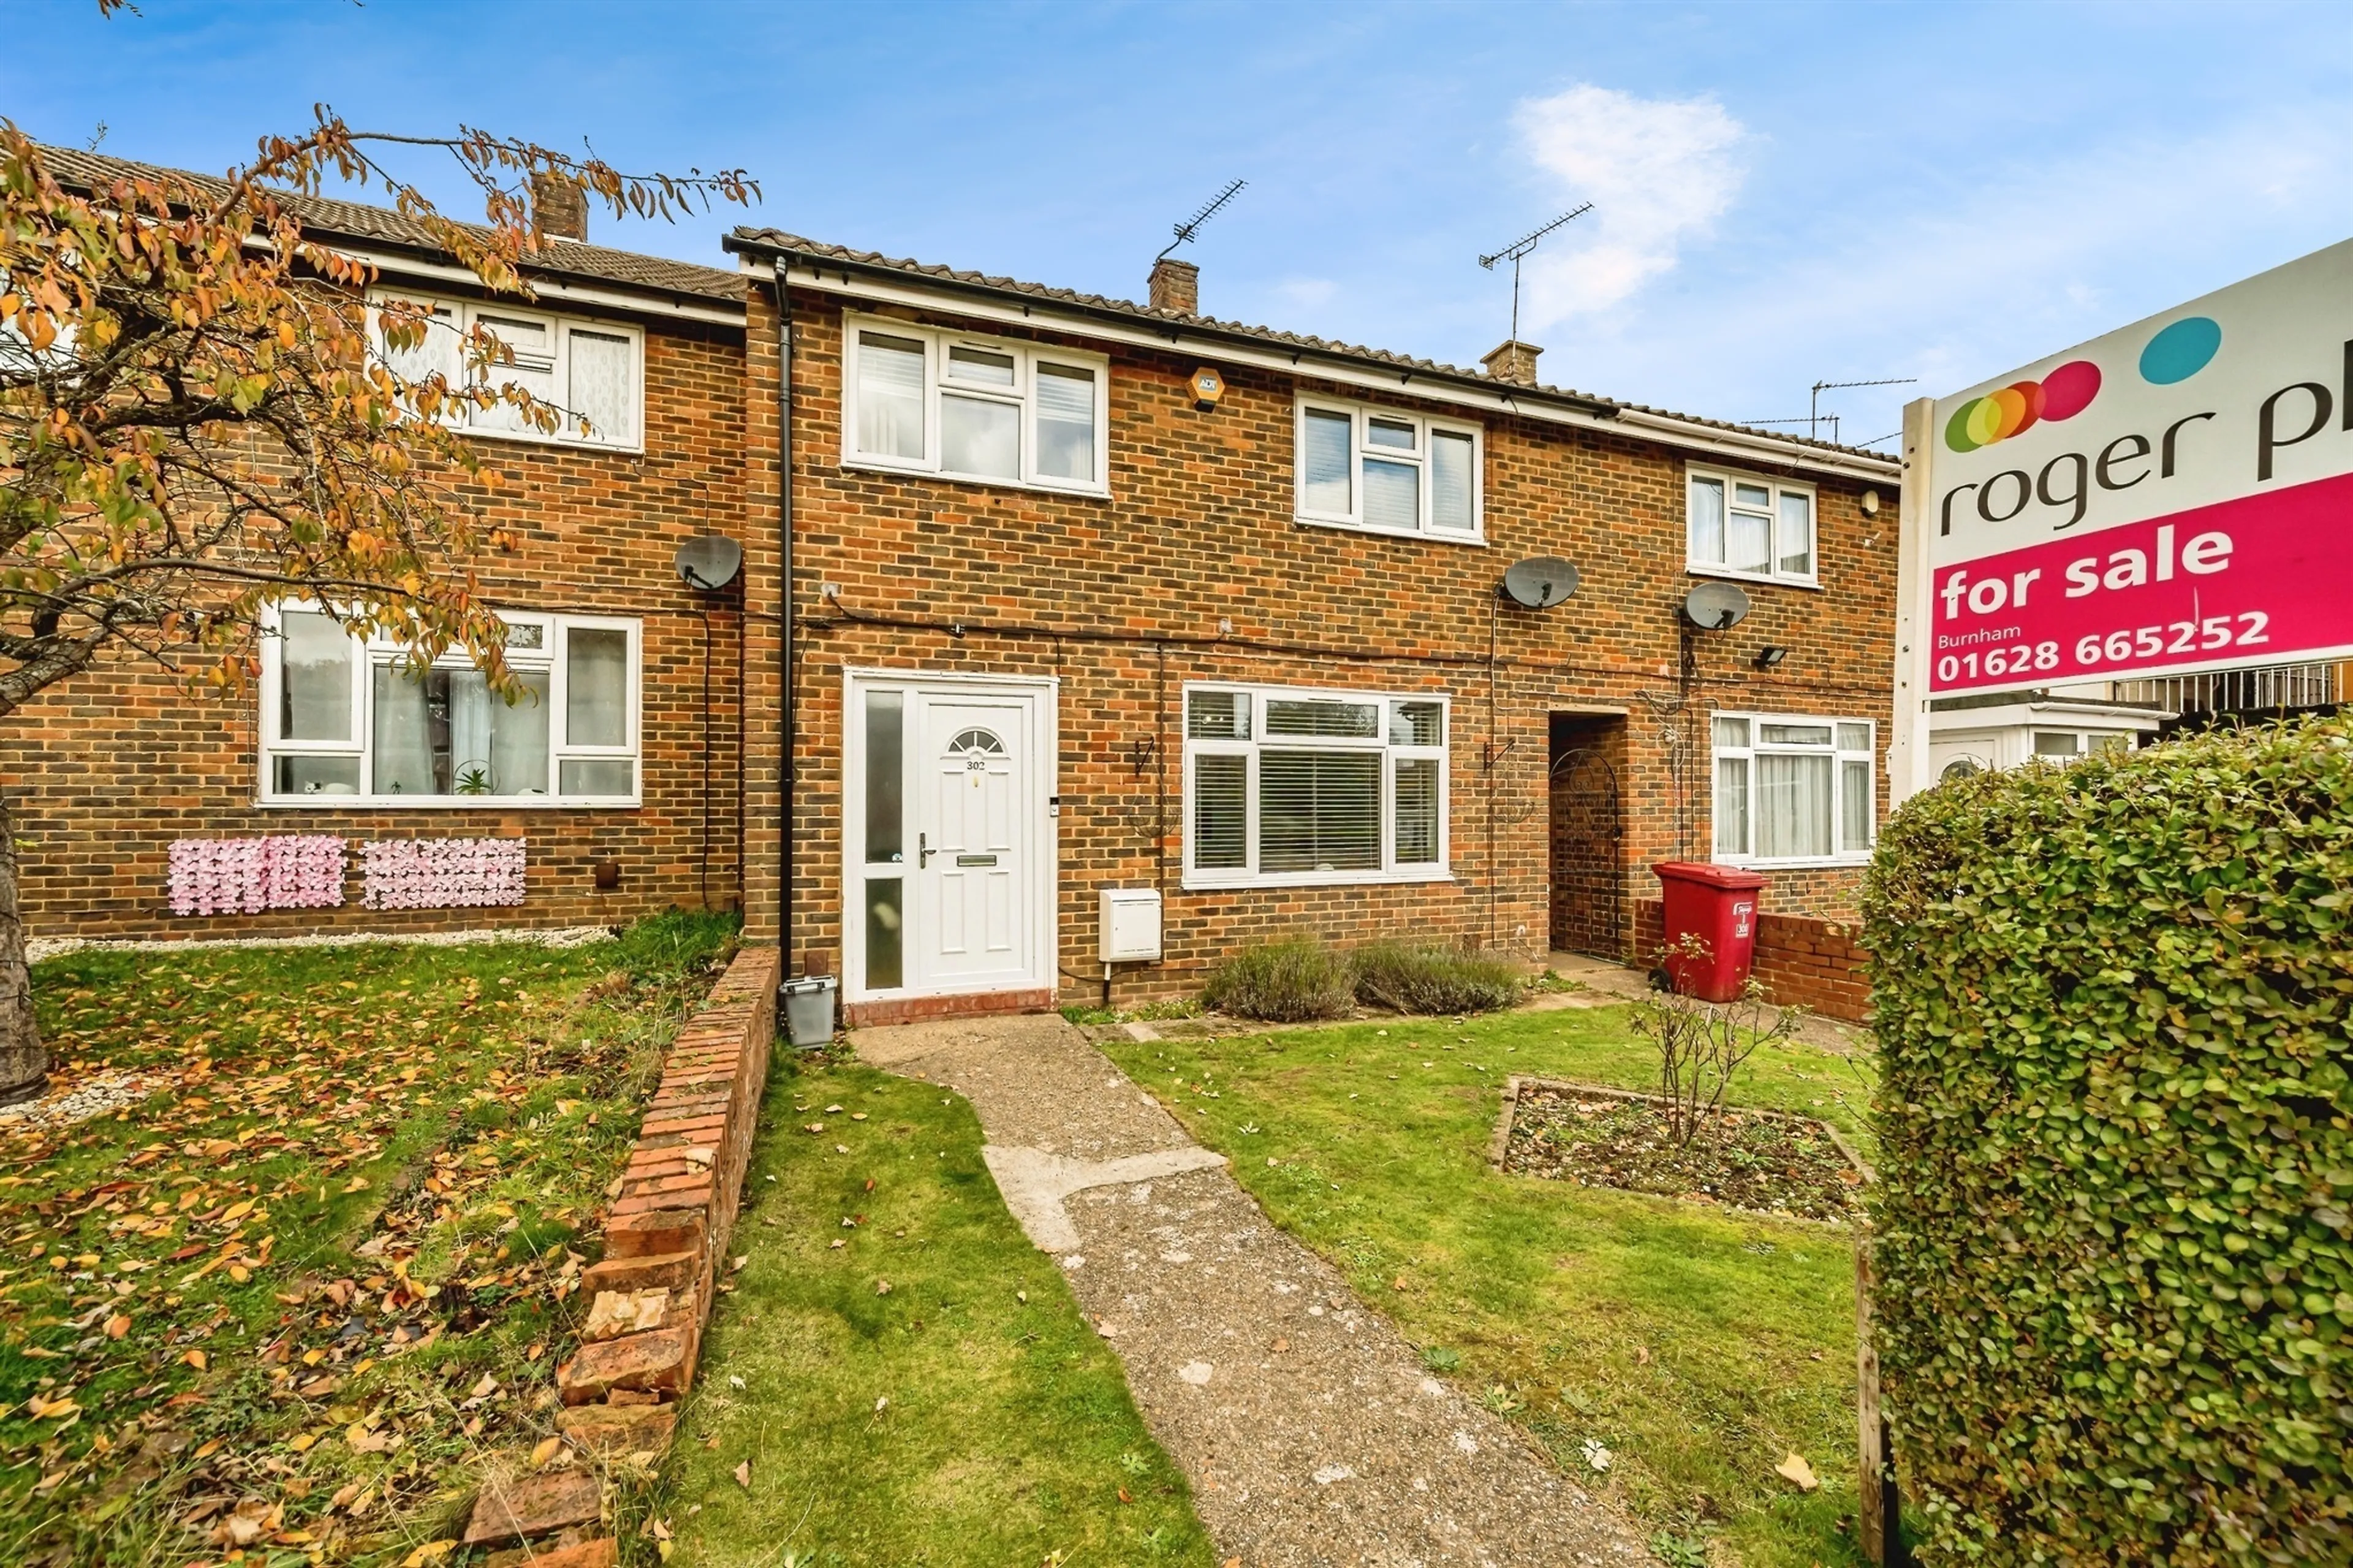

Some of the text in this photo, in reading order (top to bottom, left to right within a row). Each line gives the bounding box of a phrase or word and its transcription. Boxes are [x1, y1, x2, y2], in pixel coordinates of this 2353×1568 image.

[1941, 412, 2217, 536] roger
[1940, 525, 2234, 620] for sale
[1938, 626, 2021, 650] Burnham
[1938, 611, 2269, 682] 01628 665252
[967, 761, 985, 771] 302
